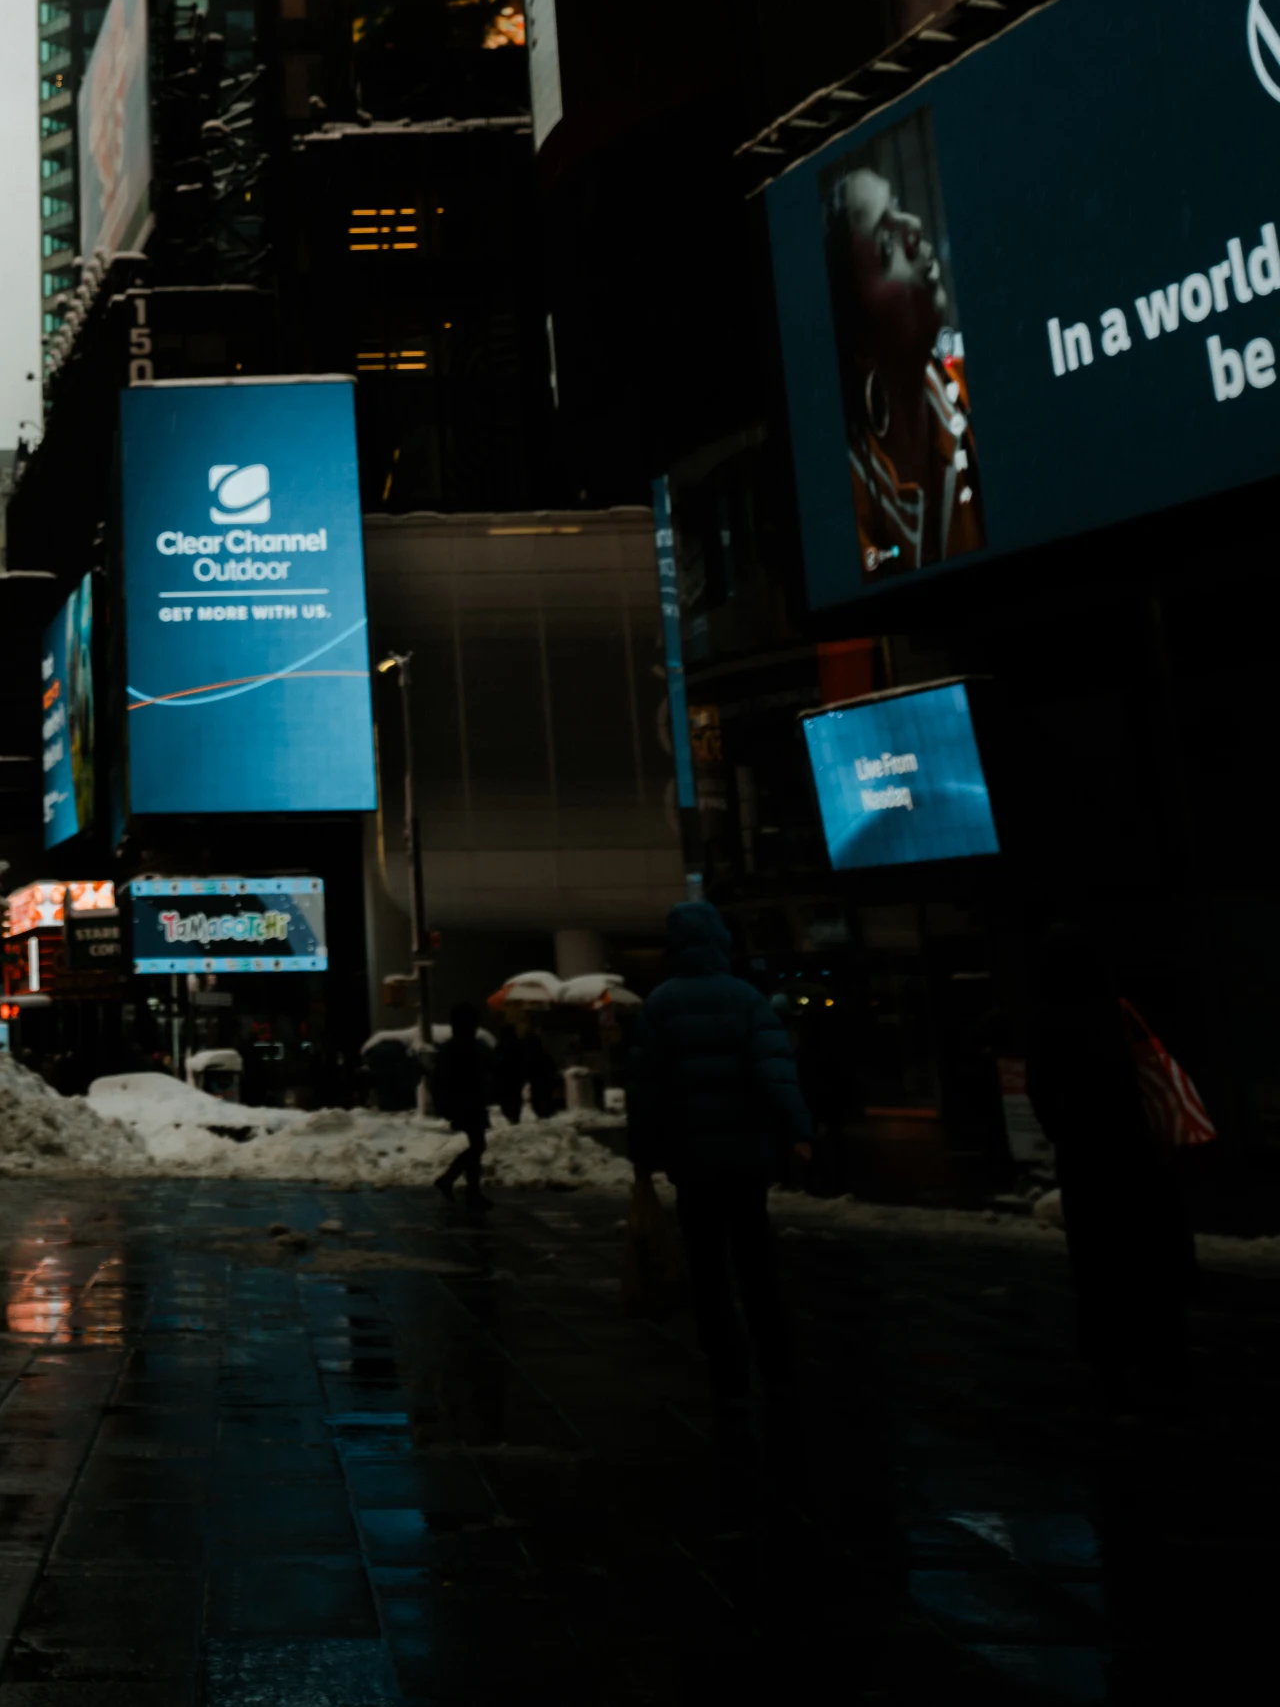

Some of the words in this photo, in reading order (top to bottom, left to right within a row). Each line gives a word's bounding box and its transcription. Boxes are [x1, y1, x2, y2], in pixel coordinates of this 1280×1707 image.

[1046, 316, 1094, 378] In
[1099, 306, 1133, 358] a
[1133, 220, 1280, 341] world
[1205, 333, 1278, 403] be
[155, 530, 224, 556] Clear
[224, 528, 328, 554] Channel
[192, 557, 292, 583] Outdoor
[158, 606, 194, 623] GET
[196, 605, 249, 622] MORE
[251, 604, 298, 621] WITH
